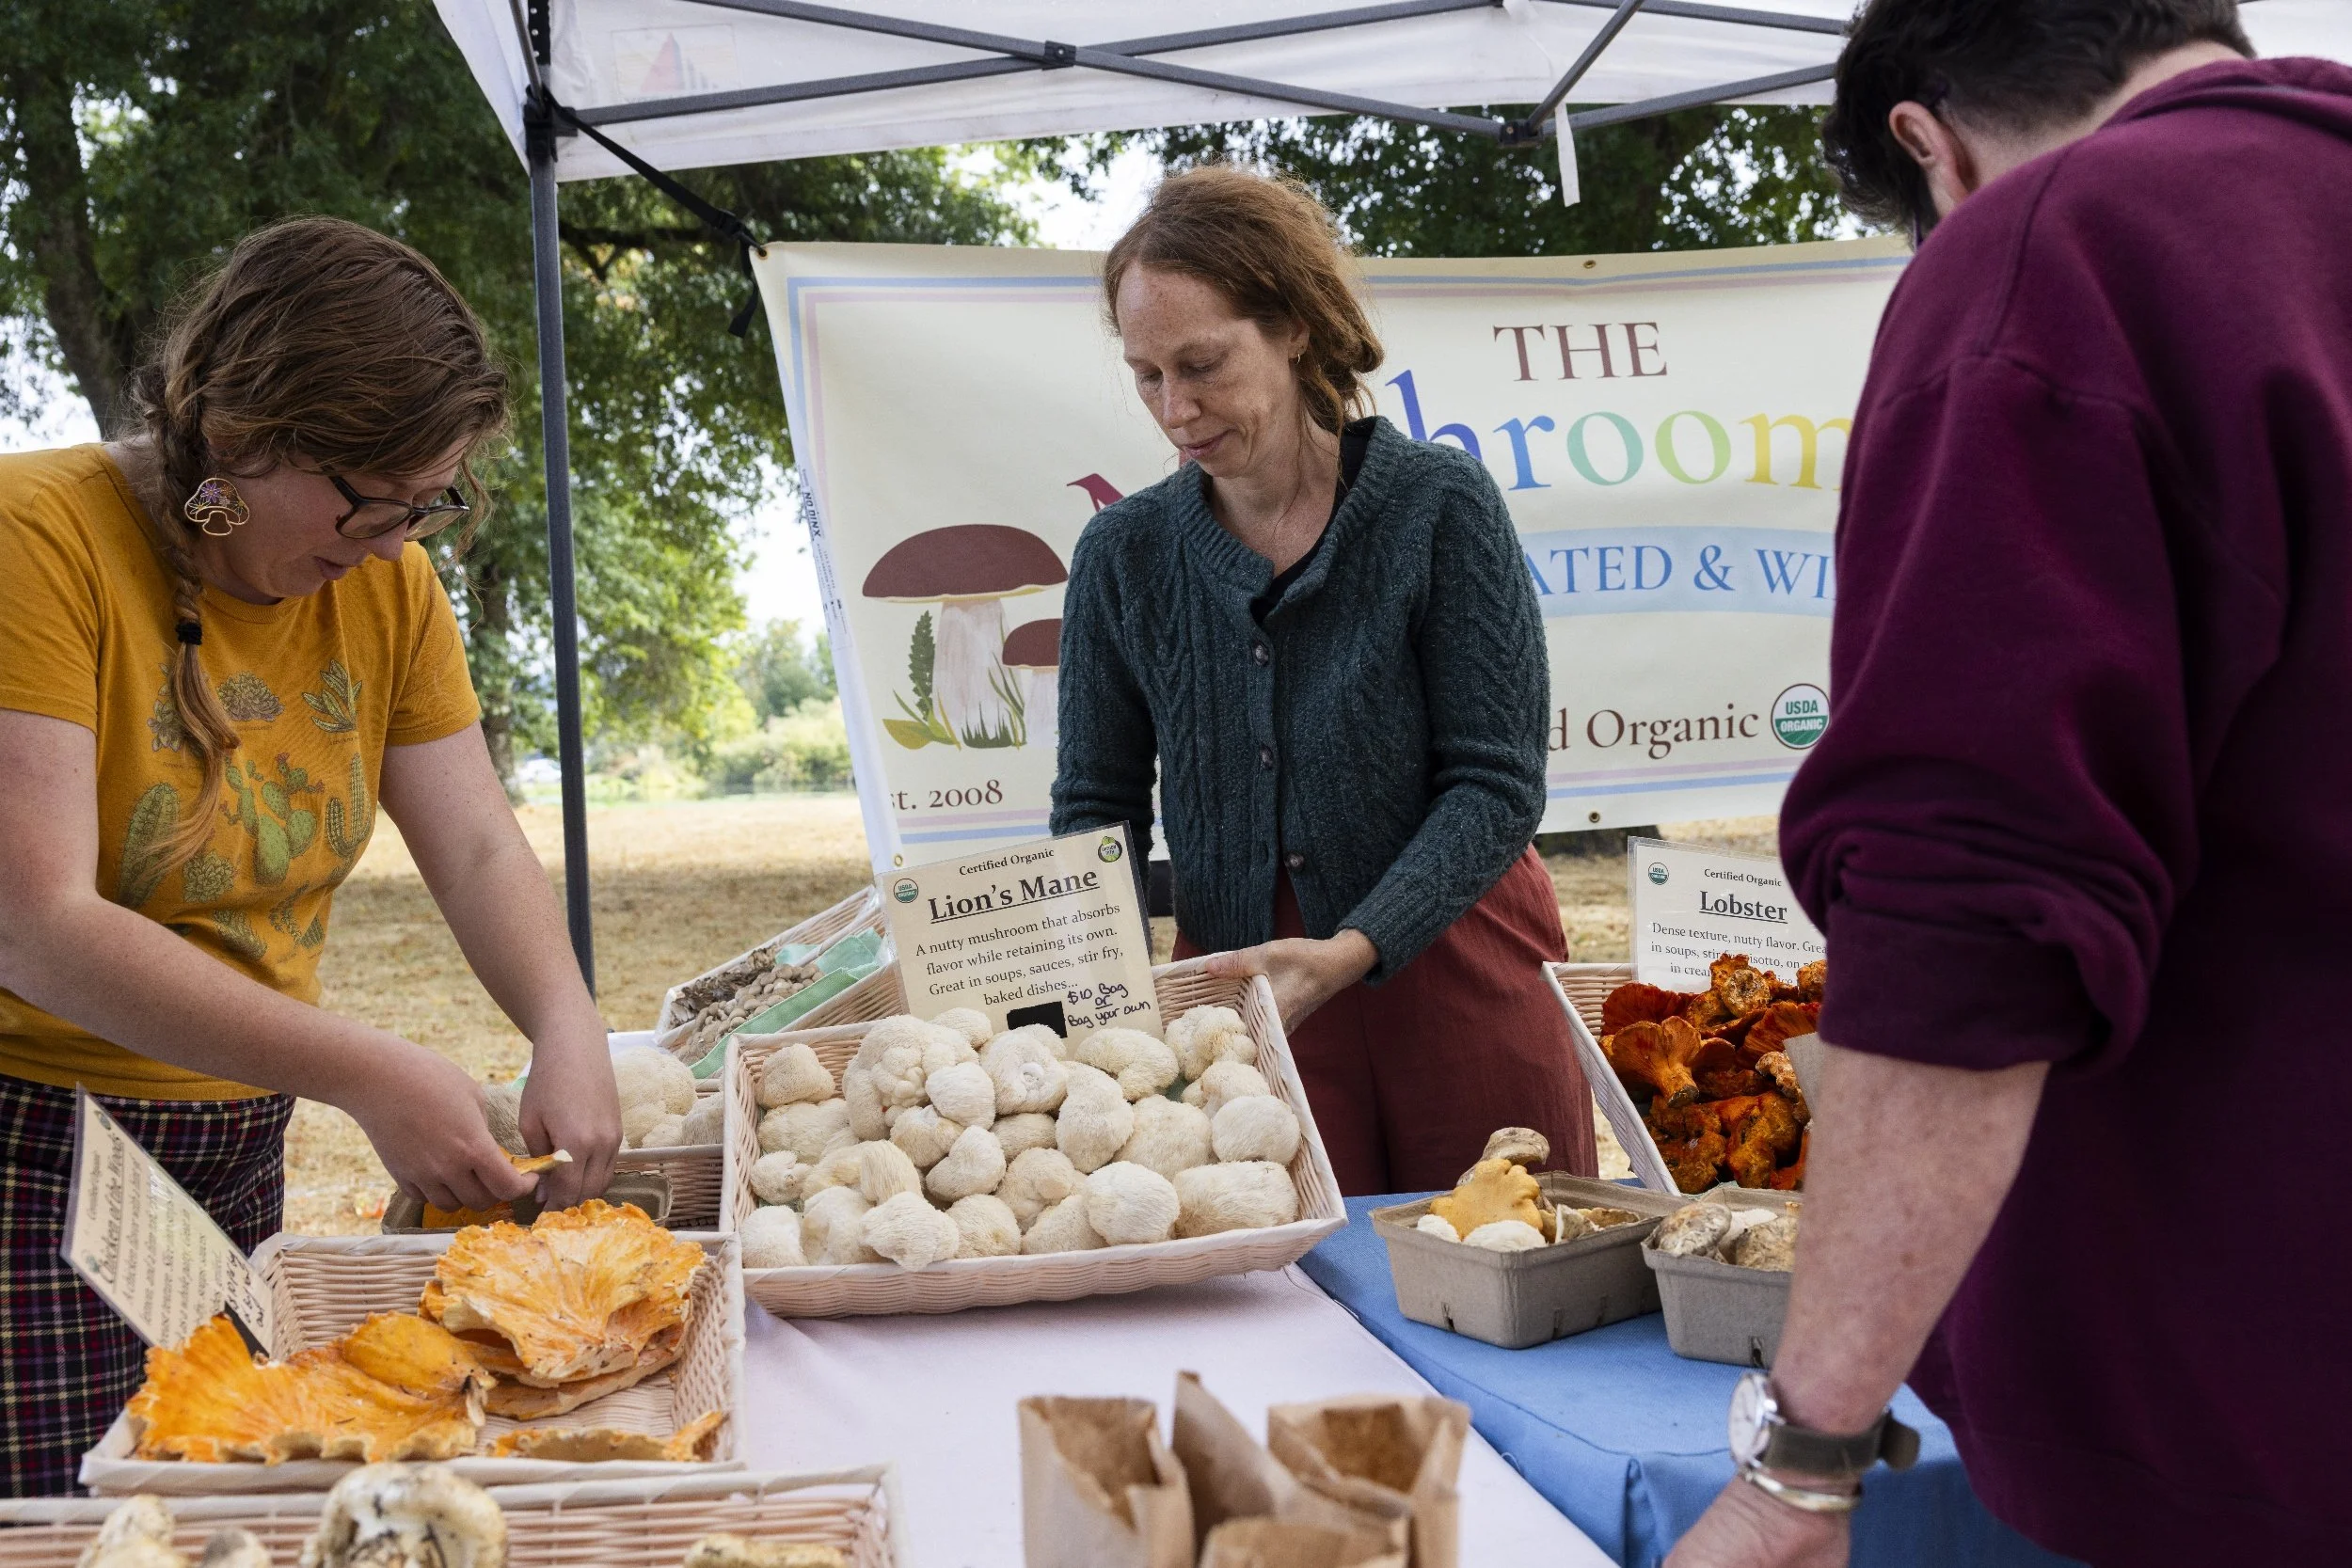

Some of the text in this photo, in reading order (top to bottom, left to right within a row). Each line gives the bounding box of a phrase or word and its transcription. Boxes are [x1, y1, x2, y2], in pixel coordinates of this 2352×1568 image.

[1493, 322, 1667, 382] THE
[1693, 545, 1736, 591] &
[1754, 548, 1836, 600] WI
[1786, 700, 1819, 715] USDA
[1586, 703, 1759, 760] Organic
[1780, 719, 1823, 733] ORGANIC
[930, 779, 1003, 808] 2008
[959, 848, 1055, 876] Certified Organic
[1704, 868, 1782, 887] Certified Organic
[928, 871, 1099, 921] Lion's Mane
[1699, 890, 1788, 921] Lobster
[916, 903, 1120, 957] A nutty mushroom that absorbs
[1652, 922, 1827, 954] Dense texture, nutty flavor. Grea
[927, 927, 1118, 975] flavor while retaining its own.
[1651, 941, 1661, 952] in
[1665, 944, 1700, 958] soups,
[1703, 948, 1721, 959] stir
[1749, 954, 1784, 968] isotto,
[1786, 959, 1800, 969] on
[929, 945, 1123, 996] Great in soups, sauces, stir fry,
[1670, 962, 1681, 974] in
[1684, 966, 1711, 976] crea
[983, 980, 1078, 1006] baked dishes...
[1067, 983, 1129, 1005] $10 Bag
[1094, 994, 1111, 1006] or
[1067, 1001, 1151, 1028] Bag your own
